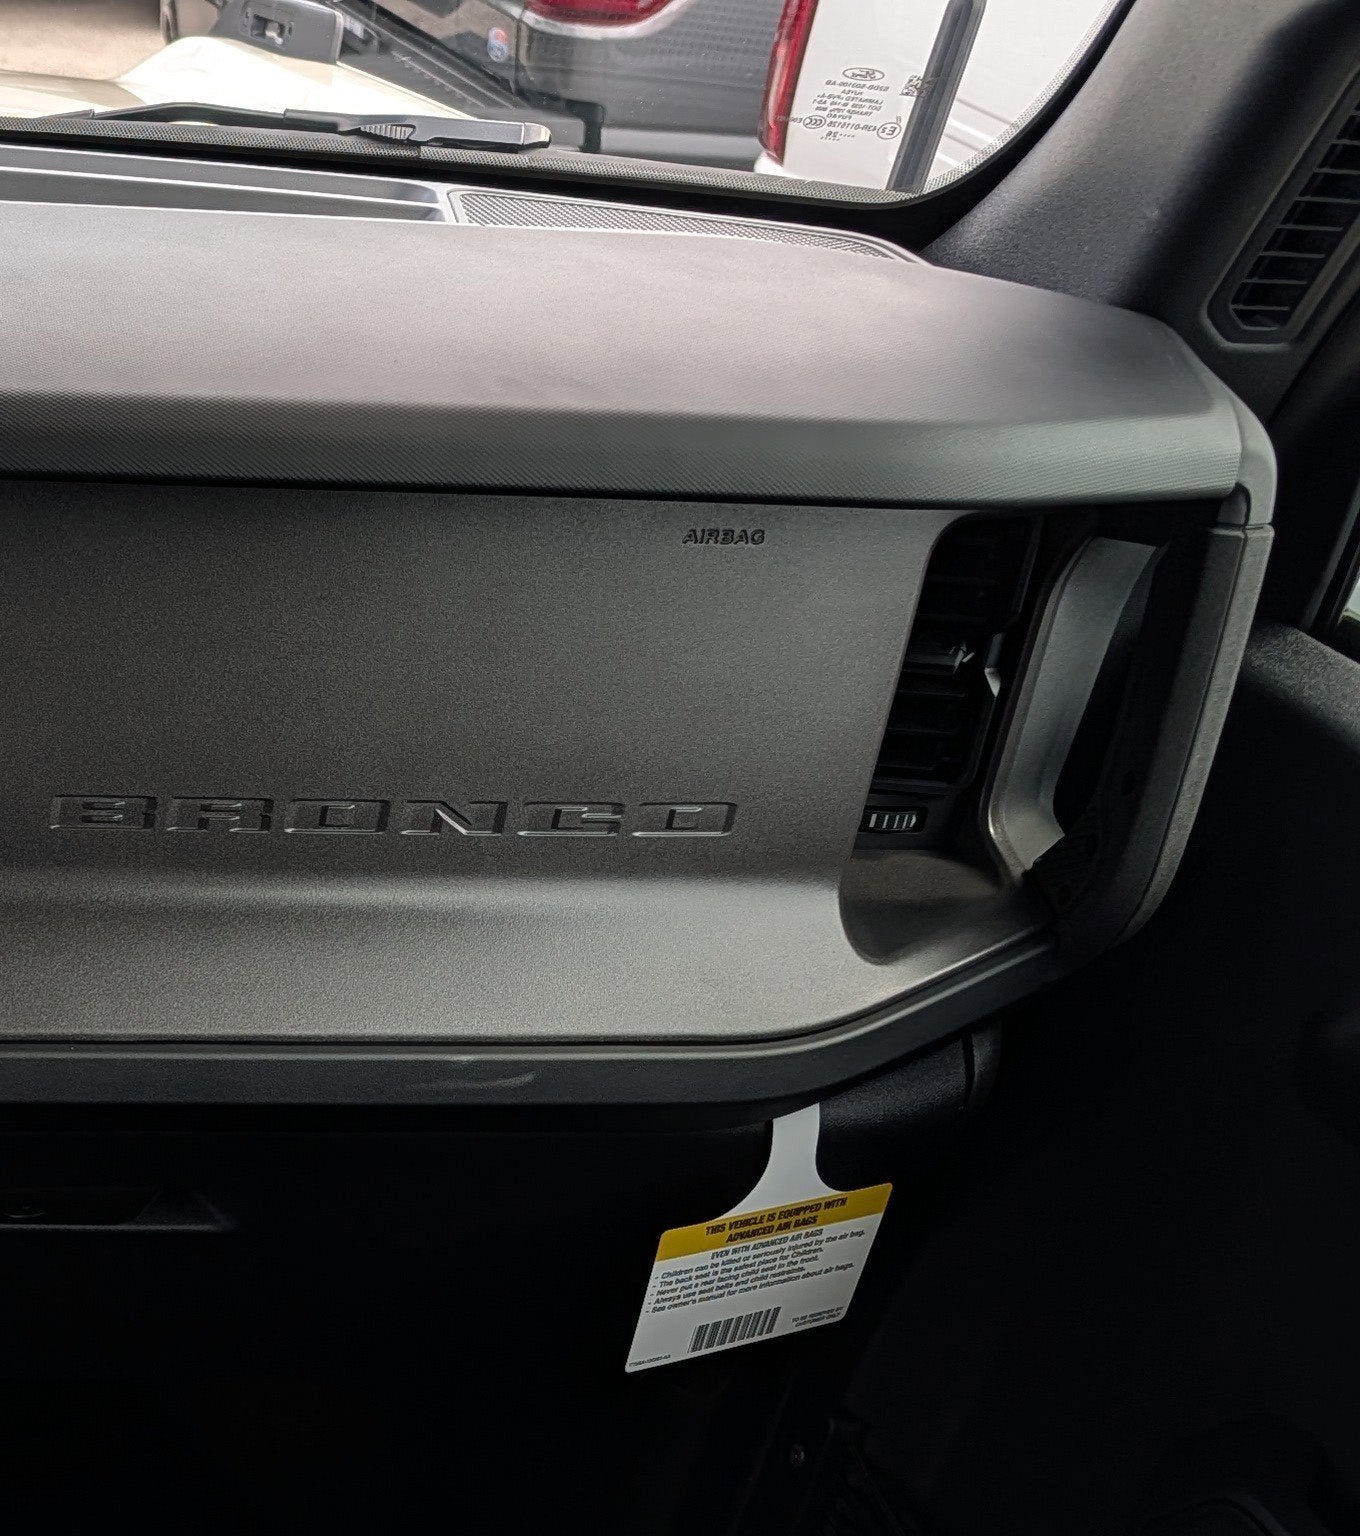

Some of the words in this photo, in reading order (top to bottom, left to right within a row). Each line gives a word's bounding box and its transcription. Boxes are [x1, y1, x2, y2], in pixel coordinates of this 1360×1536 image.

[682, 528, 765, 545] AIRBAG
[49, 794, 738, 838] BRONCO
[706, 1223, 727, 1236] THIS
[728, 1214, 766, 1231] VEHICLE
[766, 1212, 778, 1223] IS
[777, 1202, 822, 1220] EQUIPPED
[823, 1197, 848, 1210] WITH
[726, 1225, 775, 1243] ADVANCED
[775, 1220, 793, 1233] AIR
[792, 1215, 818, 1229] BAGS
[710, 1249, 730, 1260] EVEN
[731, 1244, 751, 1255] WITH
[751, 1236, 789, 1251] ADVANCED
[789, 1233, 803, 1242] AIR
[803, 1228, 824, 1239] BAGS
